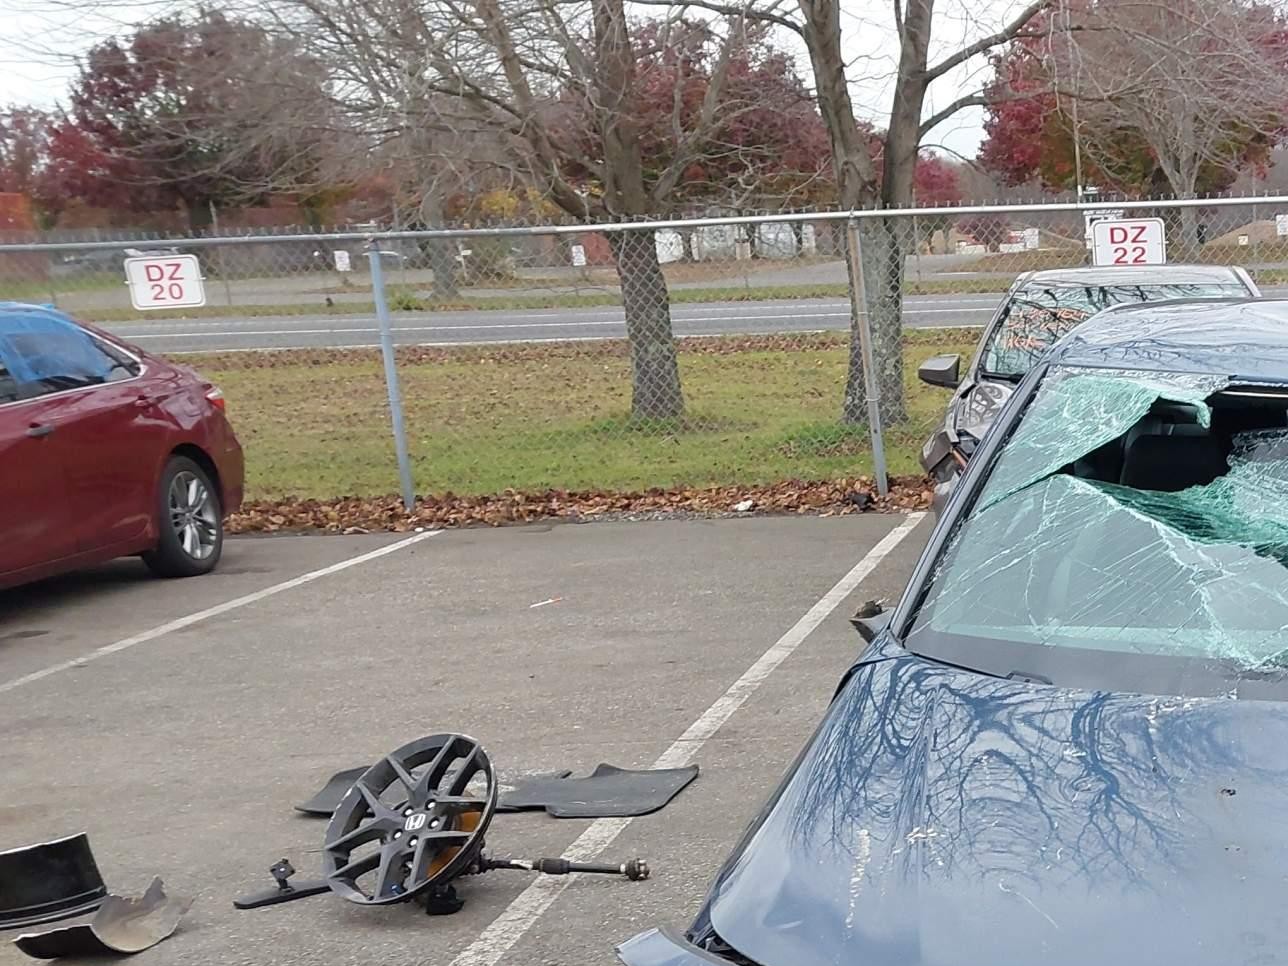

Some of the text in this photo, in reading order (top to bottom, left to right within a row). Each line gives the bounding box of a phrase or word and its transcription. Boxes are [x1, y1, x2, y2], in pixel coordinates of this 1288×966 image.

[1109, 225, 1148, 245] DZ
[1113, 246, 1147, 265] 22
[144, 263, 184, 282] DZ
[151, 283, 183, 300] 20
